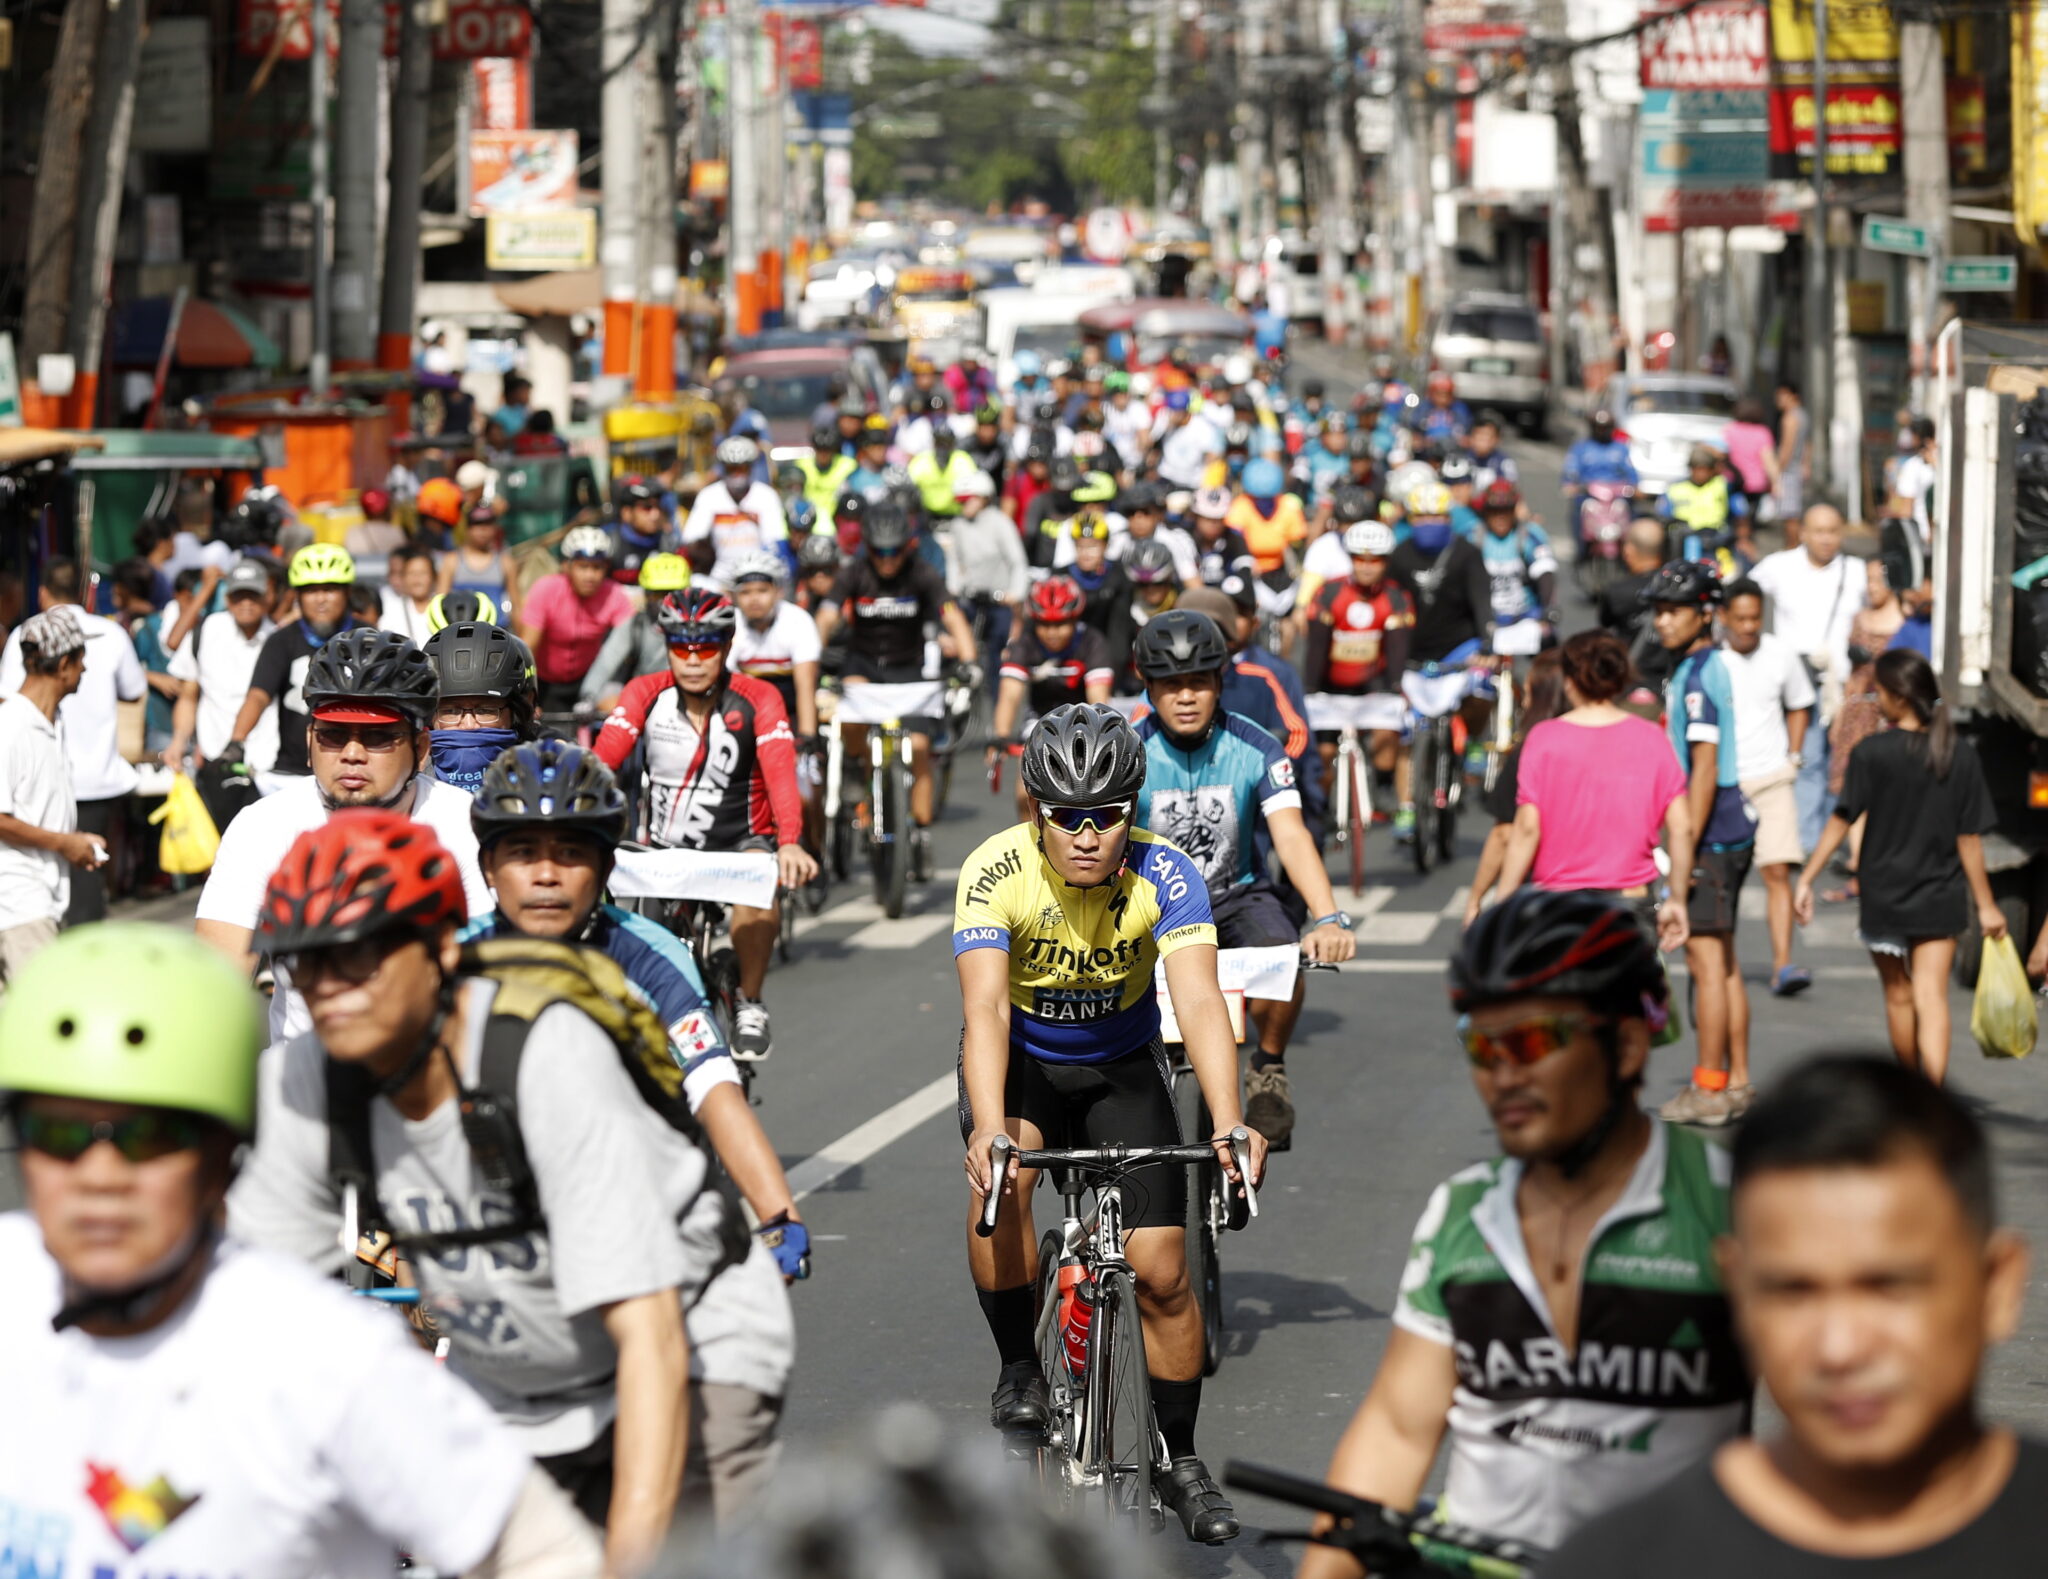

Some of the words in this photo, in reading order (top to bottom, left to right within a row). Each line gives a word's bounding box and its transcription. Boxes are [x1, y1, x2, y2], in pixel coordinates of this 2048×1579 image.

[966, 849, 1022, 907] Tinkoff
[963, 927, 999, 943] SAXO
[1166, 925, 1202, 942] Tinkoff
[1029, 936, 1143, 975] Tinkoff
[1019, 957, 1071, 984] CREDIT
[1076, 956, 1142, 985] SYSTEMS
[1040, 998, 1114, 1020] BANK
[1455, 1338, 1709, 1394] GARMIN
